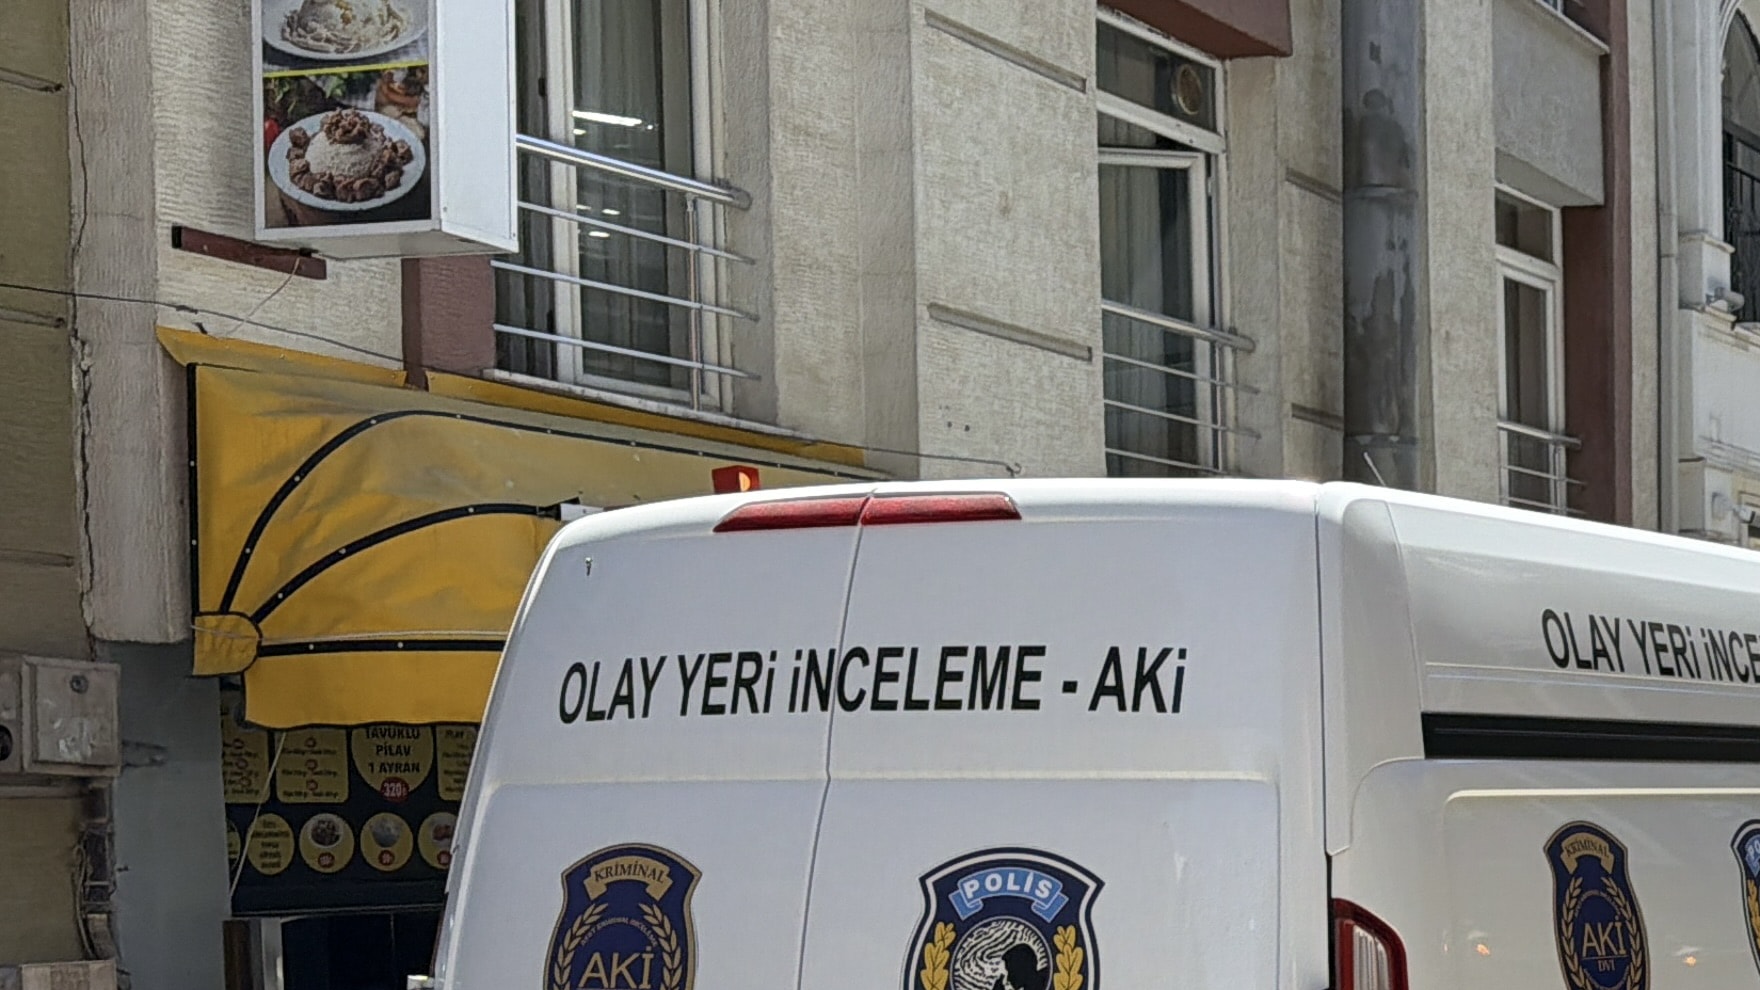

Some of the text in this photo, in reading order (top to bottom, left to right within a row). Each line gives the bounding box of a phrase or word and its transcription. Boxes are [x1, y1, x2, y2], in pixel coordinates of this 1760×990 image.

[1542, 609, 1625, 672] OLAY
[559, 656, 667, 723] OLAY
[1060, 679, 1077, 695] -
[375, 742, 411, 756] PİLAV
[368, 762, 420, 773] 1 AYRAN
[594, 860, 665, 883] KRİMİNAL
[965, 870, 1053, 899] POLİS
[1582, 915, 1627, 957] AKİ
[578, 946, 656, 989] AKİ
